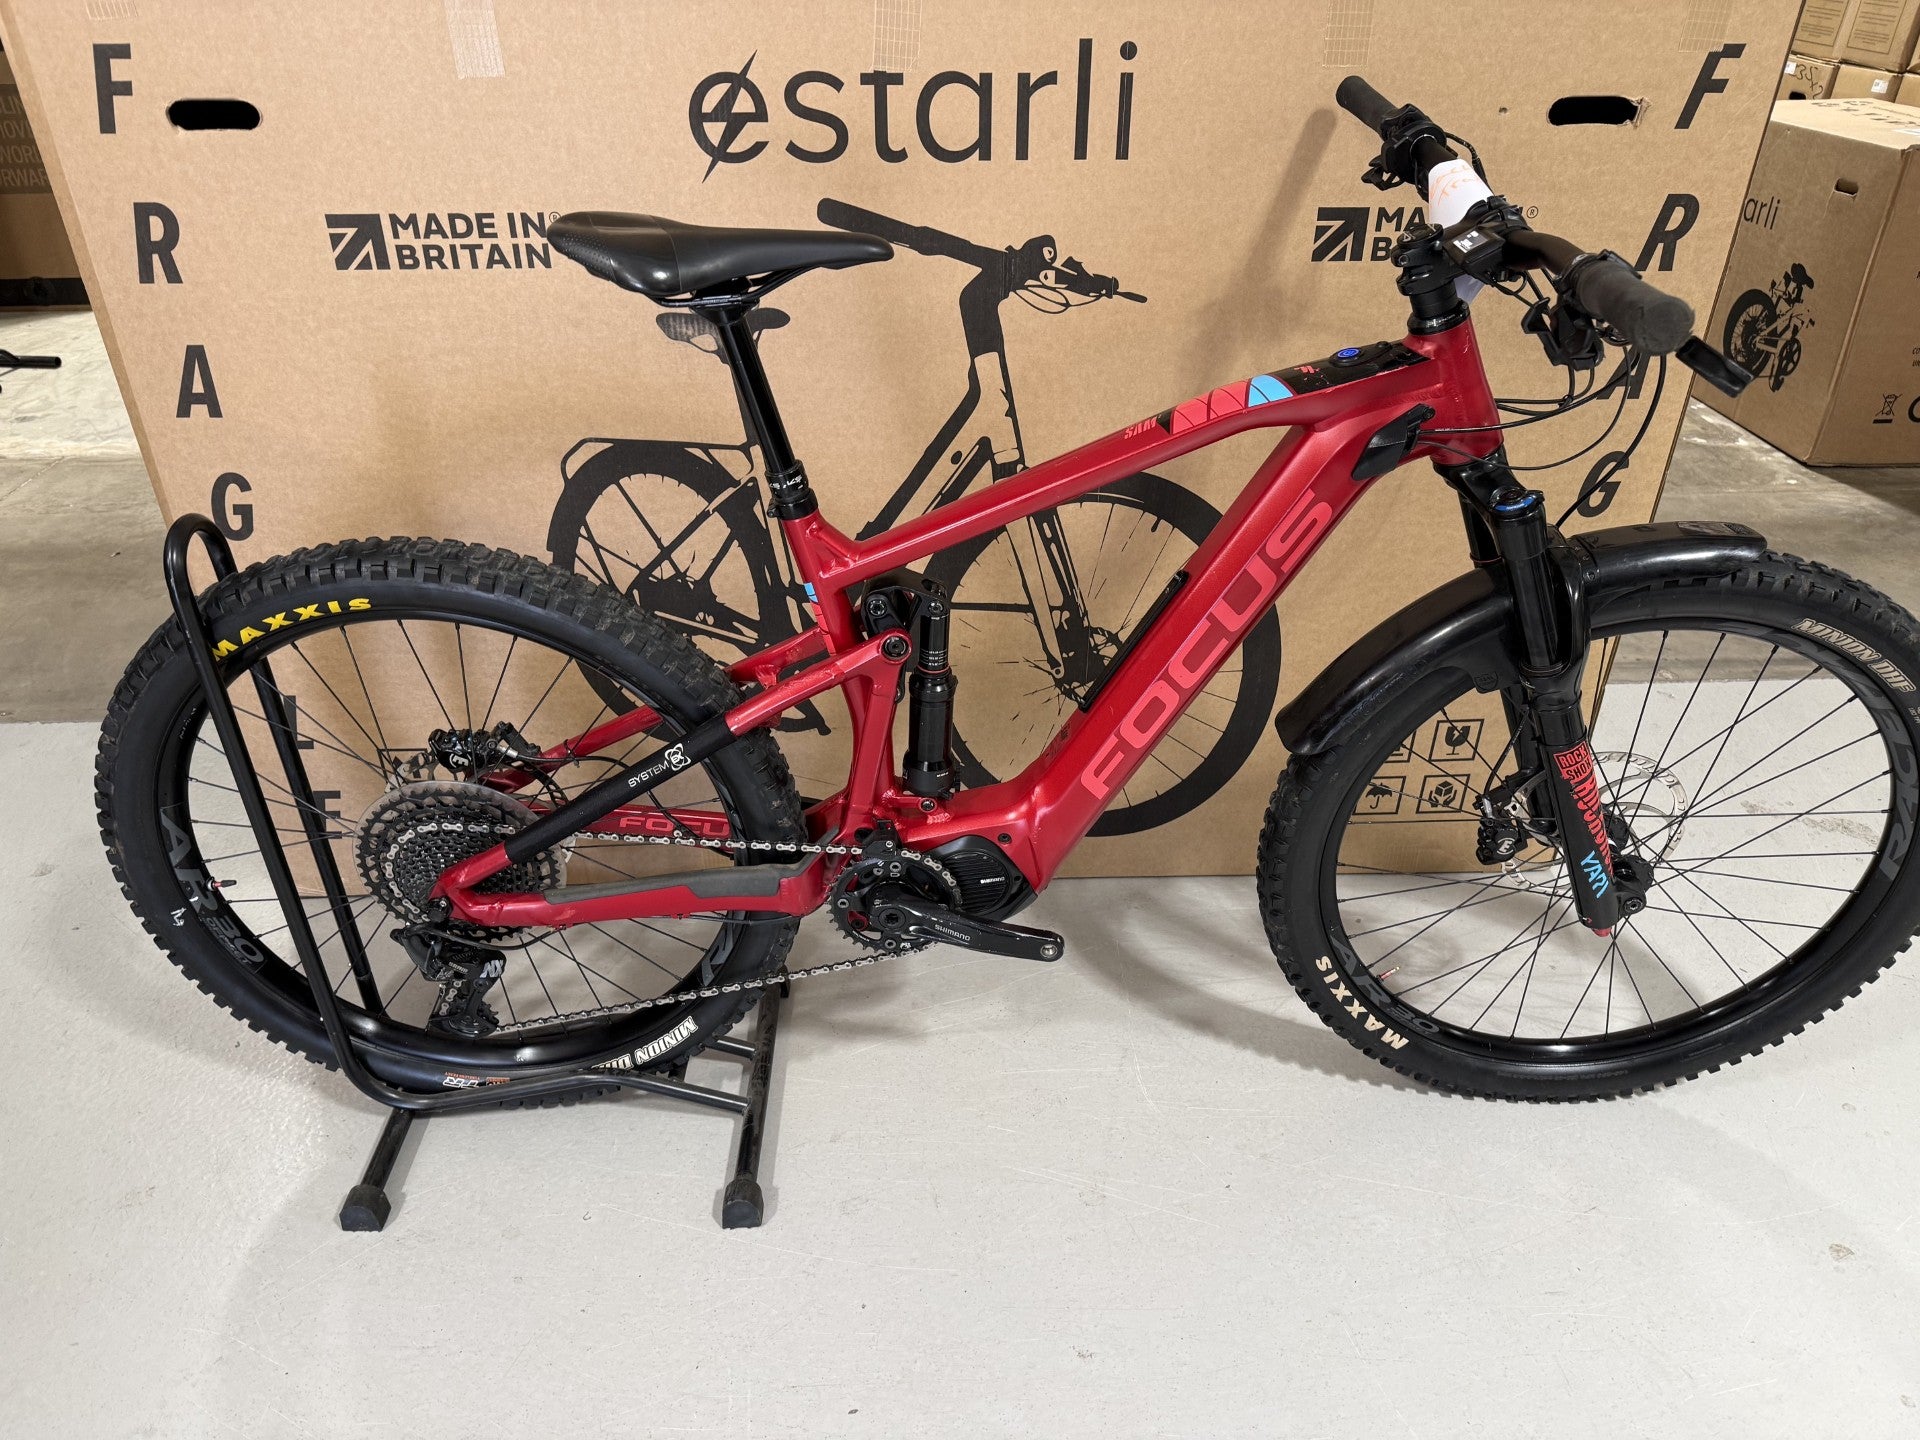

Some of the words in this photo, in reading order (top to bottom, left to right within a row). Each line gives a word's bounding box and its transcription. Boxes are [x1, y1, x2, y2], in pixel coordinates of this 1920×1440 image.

[688, 38, 1138, 181] estarli
[388, 212, 499, 240] MADE
[1375, 206, 1427, 232] MA
[395, 243, 553, 270] BRITAIN
[212, 598, 372, 663] MAXXIS
[1080, 488, 1333, 800] FOCUS
[1791, 617, 1883, 663] MINION
[1868, 658, 1916, 693] DHF
[628, 760, 670, 788] SYSTEM
[1558, 744, 1590, 769] ROCK
[1580, 850, 1610, 899] YARI
[934, 924, 971, 941] SHIMANO
[1315, 955, 1410, 1050] MAXXIS
[634, 1015, 699, 1066] MINION
